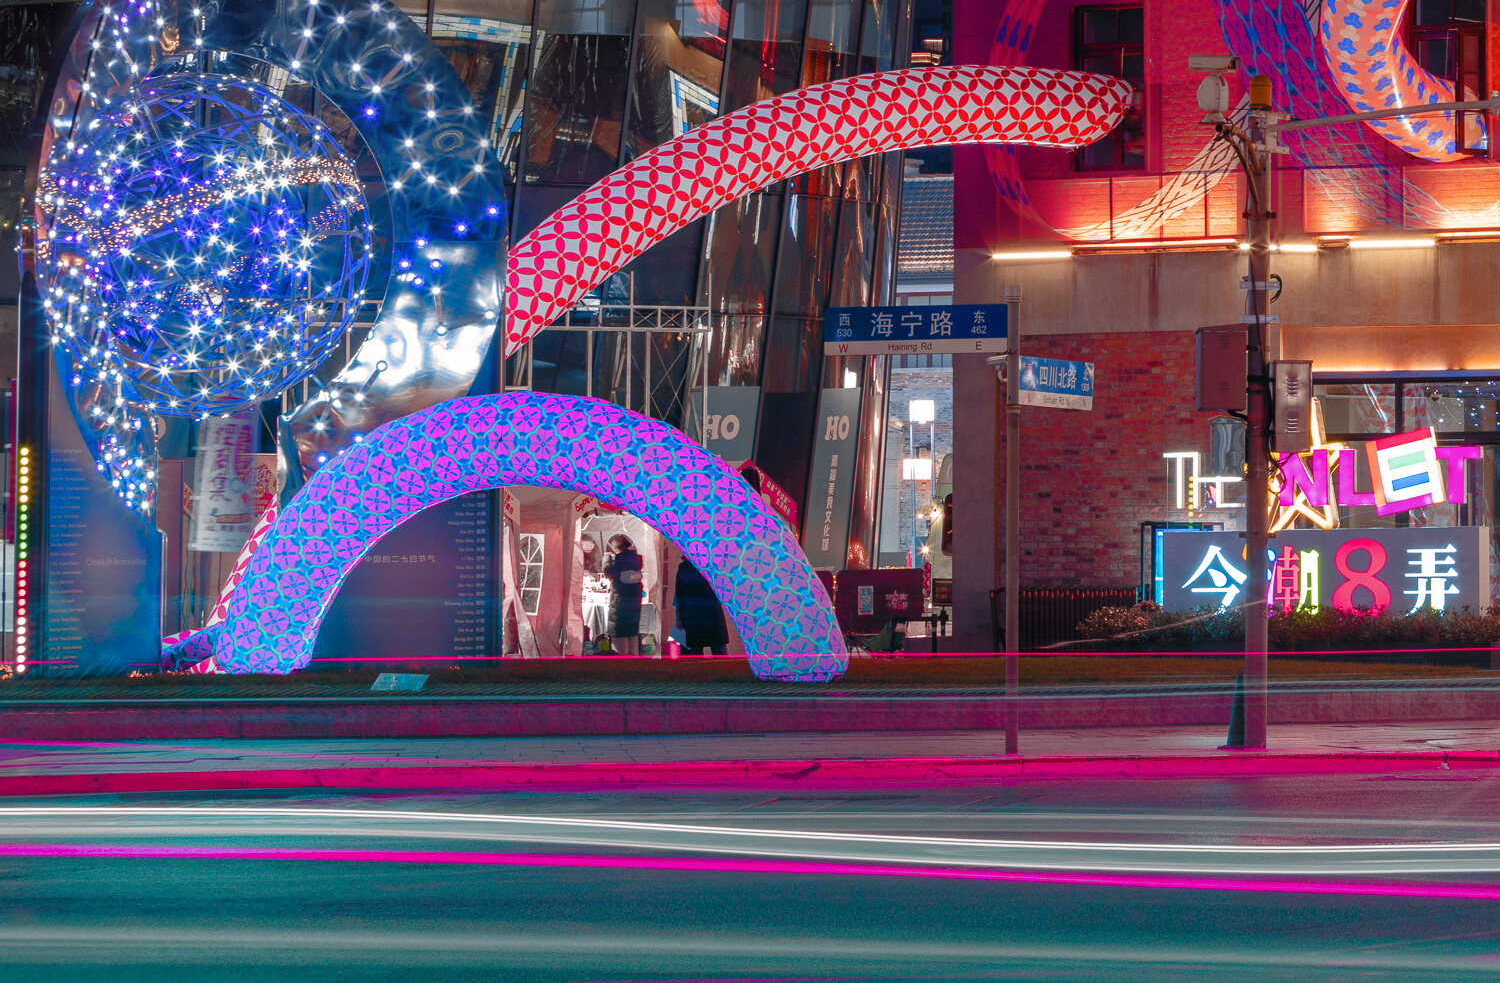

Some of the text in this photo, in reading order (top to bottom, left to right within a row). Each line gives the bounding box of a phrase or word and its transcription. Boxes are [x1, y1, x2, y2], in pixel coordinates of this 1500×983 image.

[836, 325, 987, 338] 530 462
[839, 310, 986, 337] 西 海宁路 东
[838, 344, 849, 353] W
[888, 342, 917, 353] Haining
[975, 341, 982, 351] E
[1039, 365, 1077, 390] 四川北路
[824, 415, 850, 441] HO
[1182, 543, 1460, 617] 今潮8弄
